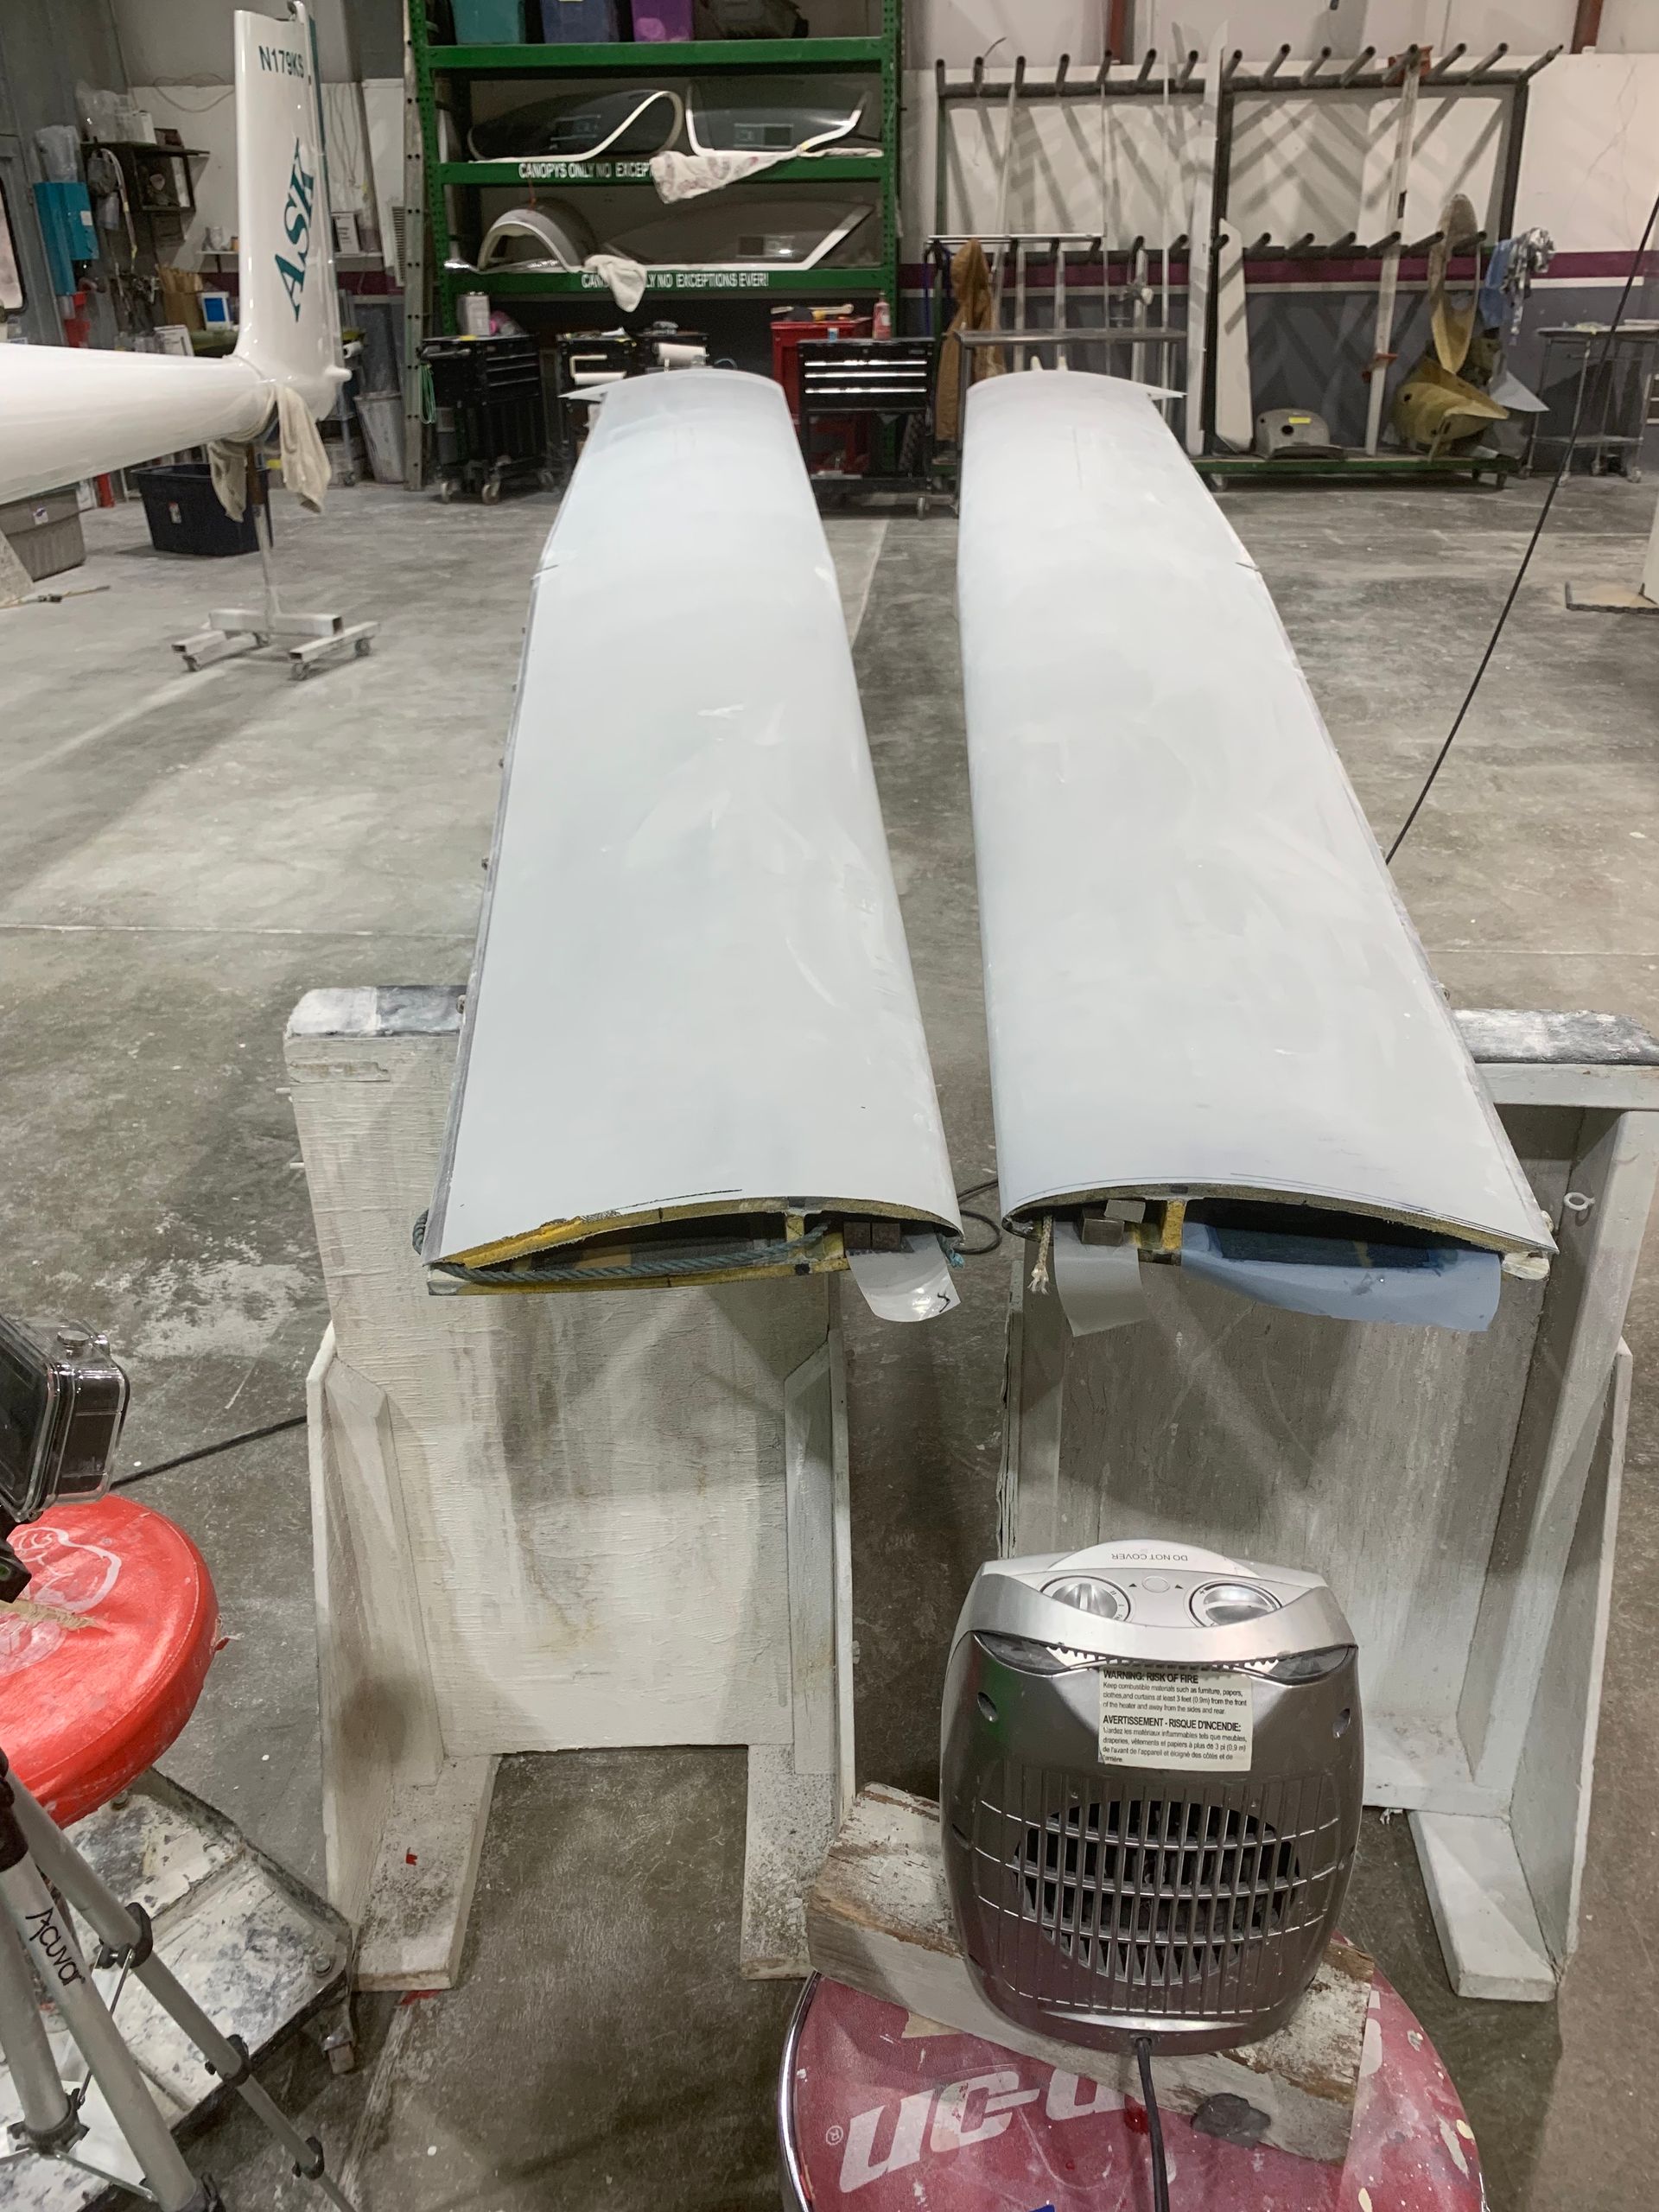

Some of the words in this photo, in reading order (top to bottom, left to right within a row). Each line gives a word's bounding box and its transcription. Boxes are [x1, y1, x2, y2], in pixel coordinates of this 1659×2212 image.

[258, 46, 304, 79] N179KS
[518, 162, 568, 179] CANOPYS
[568, 162, 594, 178] ONLY
[595, 162, 612, 178] NO
[615, 162, 651, 178] EXCEP
[275, 137, 314, 322] ASK
[658, 273, 673, 288] NO
[676, 272, 738, 288] EXCEPTIONS
[739, 272, 769, 287] EVER!
[1103, 1669, 1145, 1681] WARNING:
[1147, 1672, 1165, 1682] RISK
[1166, 1674, 1179, 1682] OF
[1180, 1675, 1198, 1684] FIRE
[1103, 1681, 1117, 1690] Keep
[1198, 1687, 1222, 1695] furniture,
[1103, 1714, 1164, 1726] AVERTISSEMENT
[1169, 1718, 1197, 1729] RISQUE
[1198, 1720, 1241, 1732] D'INCENDIE:
[25, 1907, 86, 1986] Acuvar
